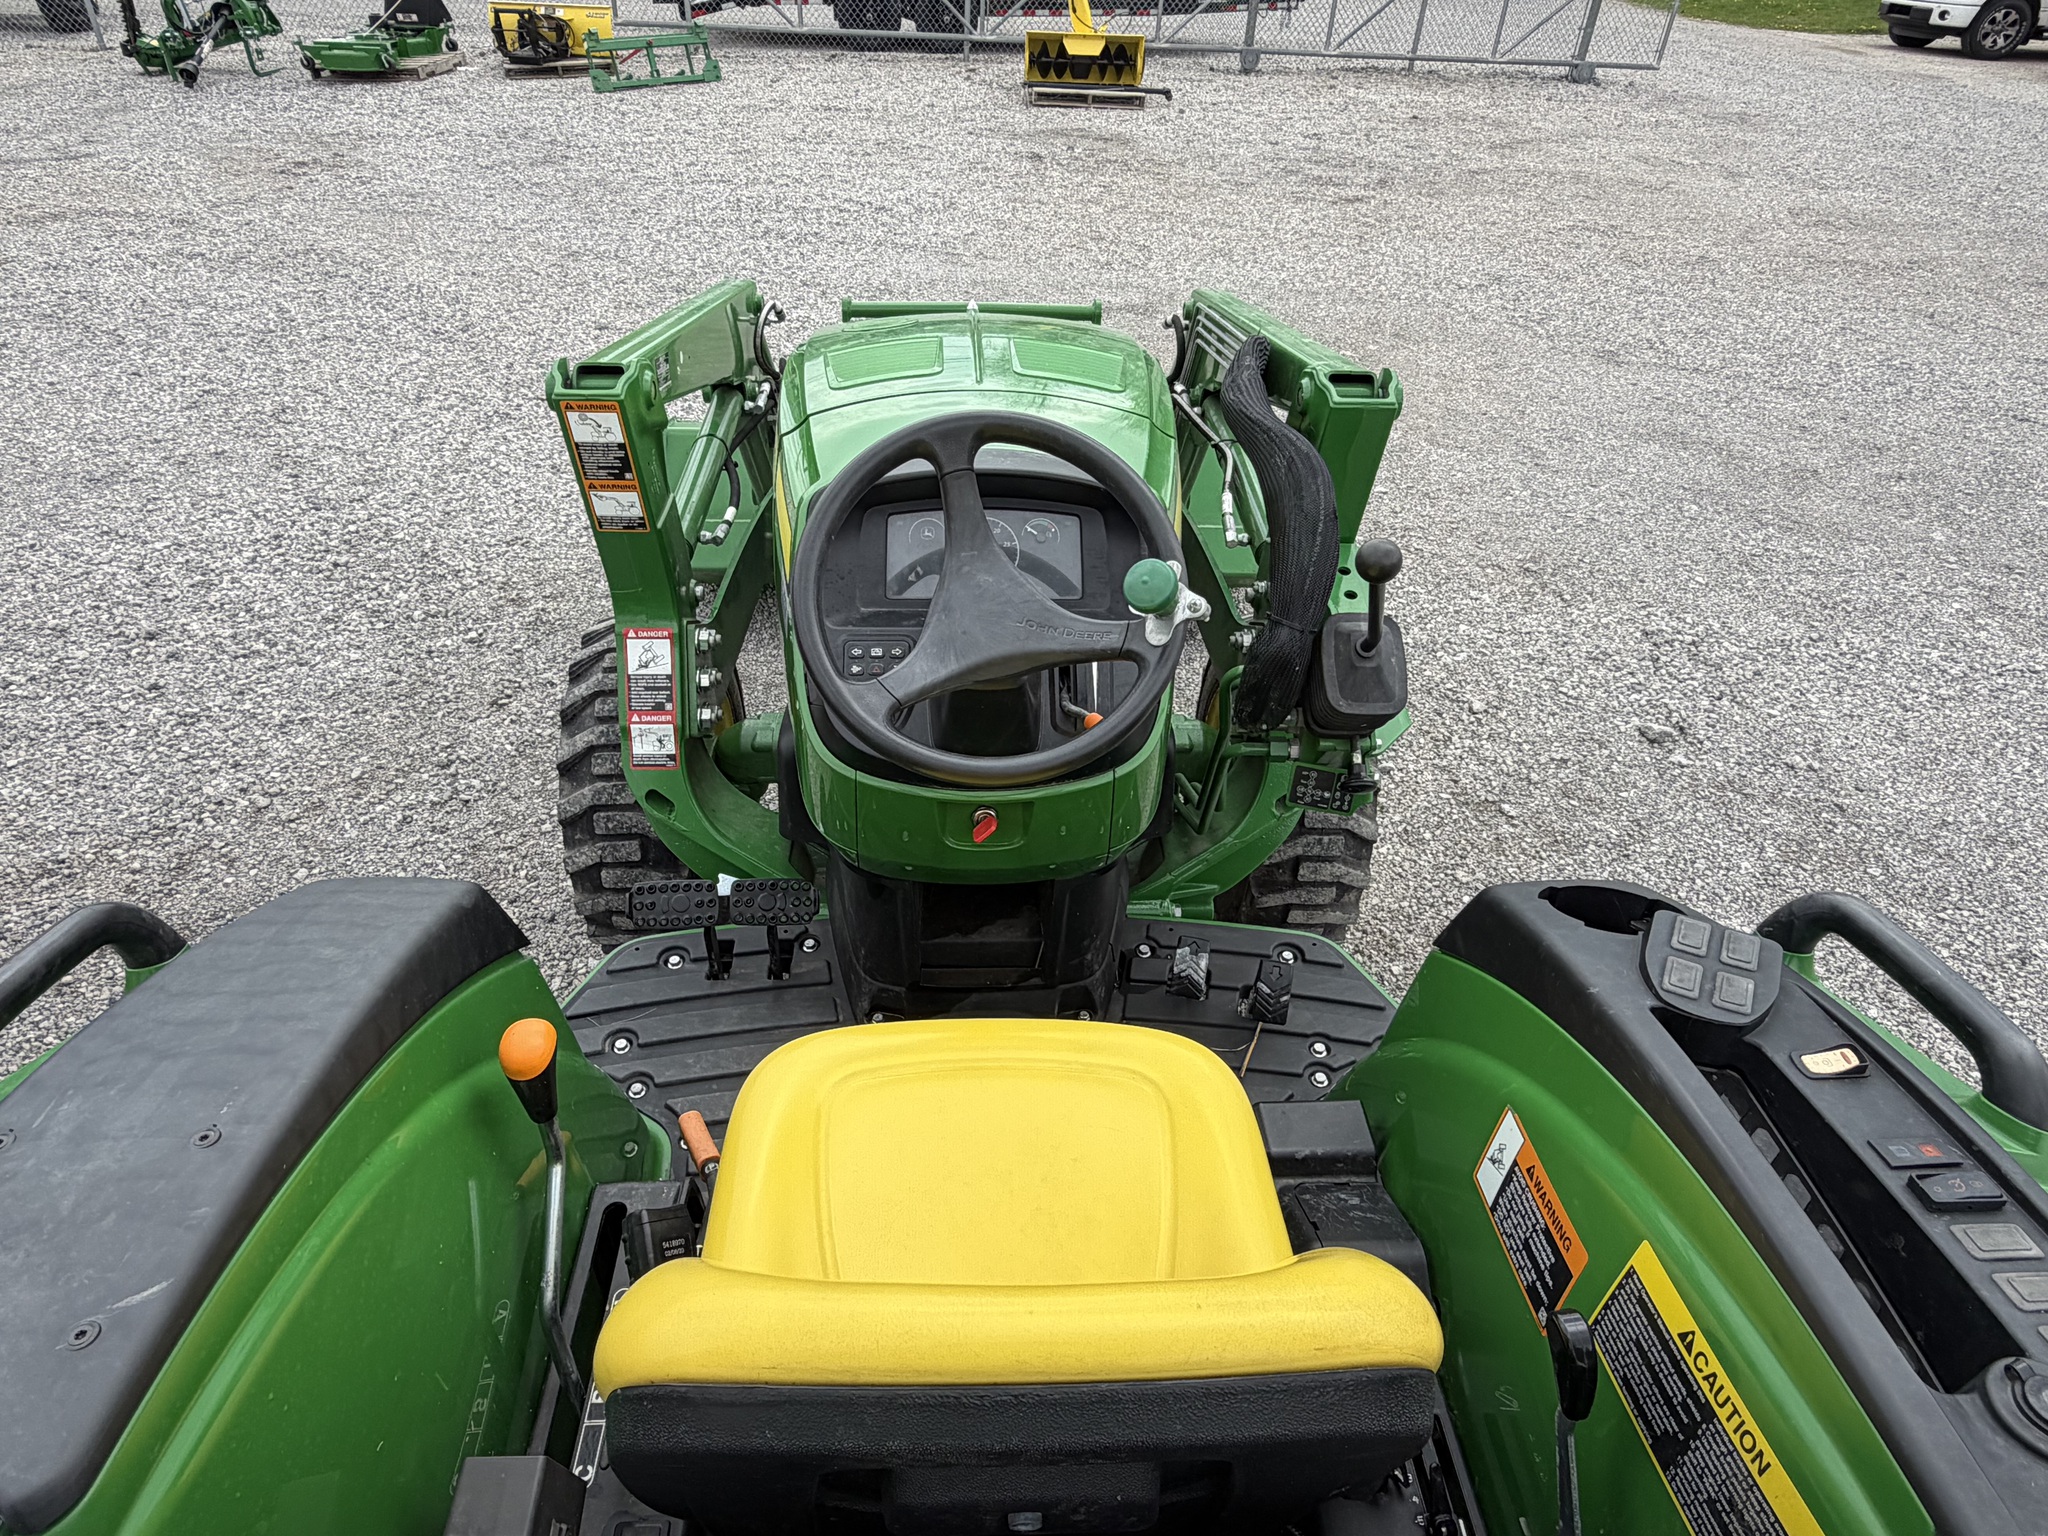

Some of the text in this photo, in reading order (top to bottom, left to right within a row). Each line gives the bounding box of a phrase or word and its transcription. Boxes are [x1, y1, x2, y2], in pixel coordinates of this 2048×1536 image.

[575, 403, 617, 411] WARNING
[637, 630, 669, 638] DANGER
[1062, 627, 1113, 641] DEERE
[641, 714, 672, 722] DANGER
[1533, 1175, 1573, 1254] WARNING
[1693, 1350, 1772, 1478] CAUTION
